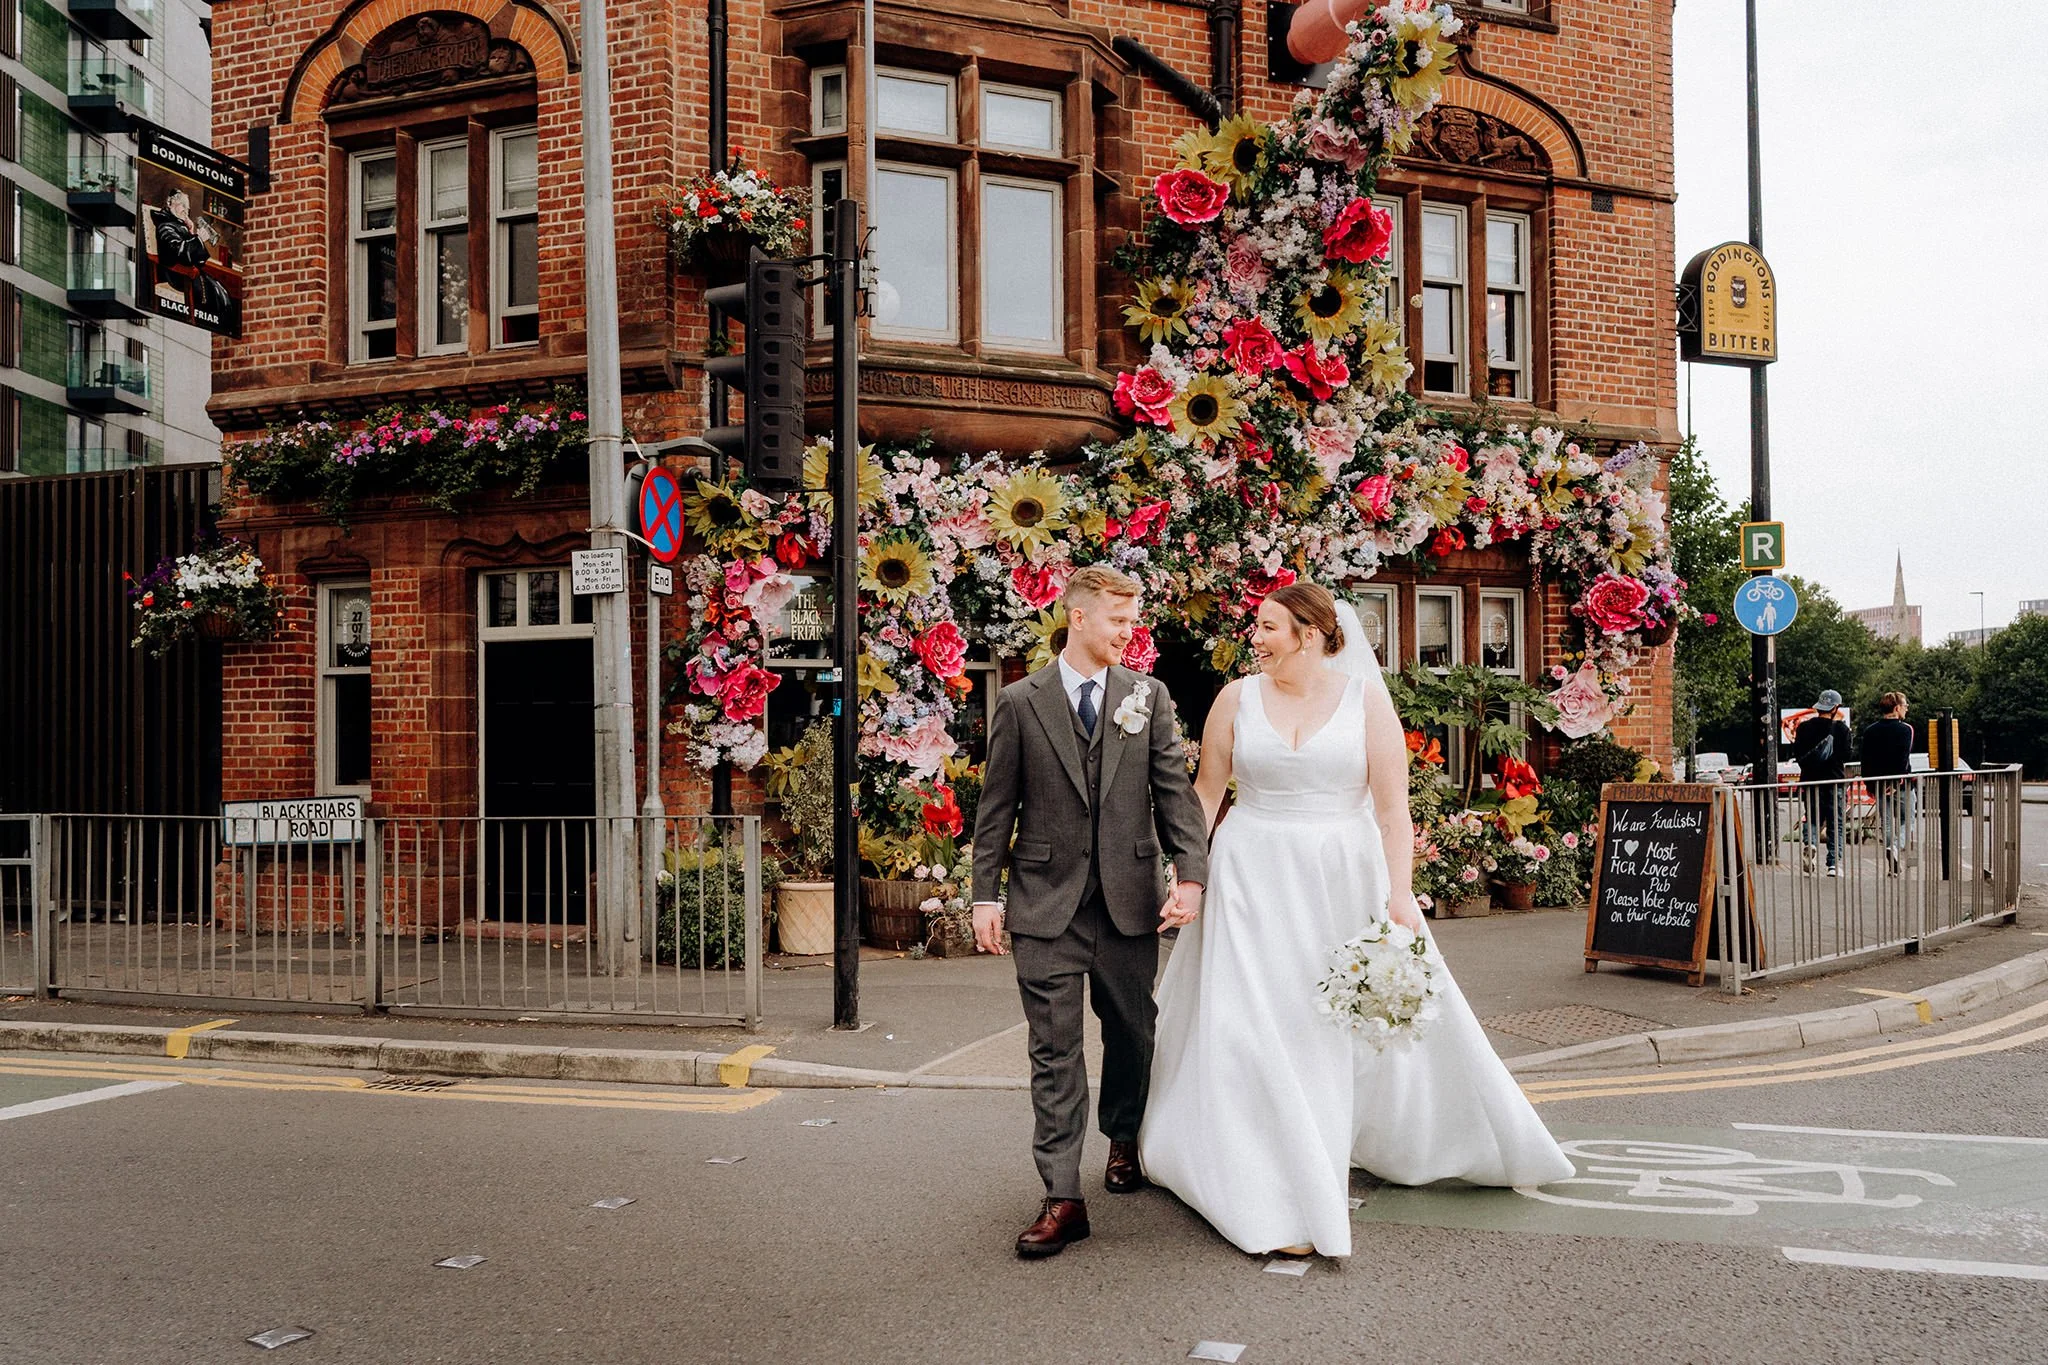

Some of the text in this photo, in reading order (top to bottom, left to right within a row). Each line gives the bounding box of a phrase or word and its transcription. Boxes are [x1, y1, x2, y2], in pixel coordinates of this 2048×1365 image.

[151, 144, 234, 186] BODDINGTONS
[1707, 248, 1770, 299] BODDINGTONS
[161, 298, 219, 325] BLACK FRIAR
[1709, 333, 1770, 352] BITTER
[1752, 532, 1775, 560] R
[654, 573, 669, 587] End
[795, 594, 817, 609] THE
[352, 612, 362, 622] 27
[790, 609, 824, 625] BLACK
[351, 623, 363, 633] 07
[791, 625, 823, 641] FRIAR
[1613, 785, 1635, 800] THE
[1635, 784, 1672, 801] BLACK
[262, 802, 356, 837] BLACKFRIARS ROAD
[1612, 807, 1702, 833] We are Finalists!
[1611, 839, 1678, 861] I Most
[1610, 858, 1680, 878] MCR Loved
[1649, 877, 1671, 892] Pub
[1605, 887, 1699, 914] Please Vote for us
[1610, 908, 1691, 927] on their website
